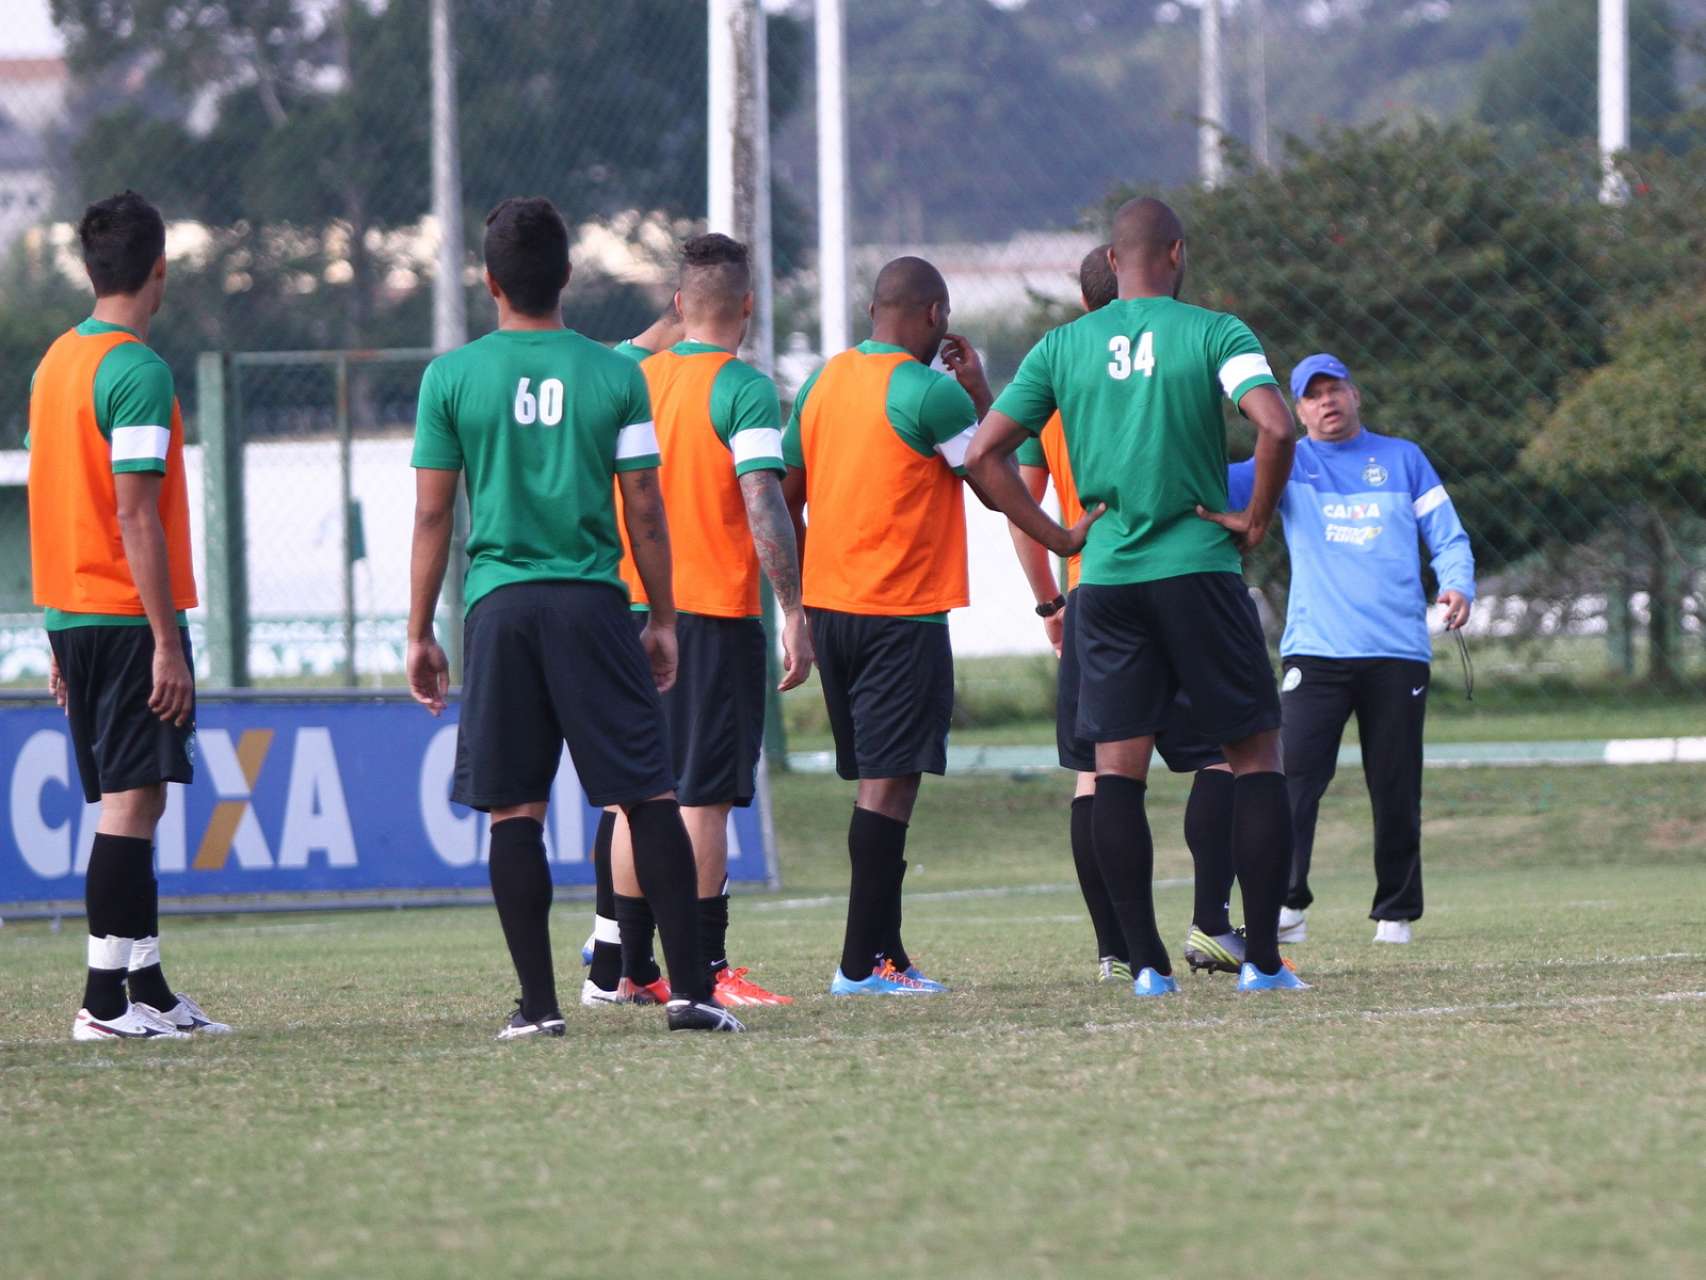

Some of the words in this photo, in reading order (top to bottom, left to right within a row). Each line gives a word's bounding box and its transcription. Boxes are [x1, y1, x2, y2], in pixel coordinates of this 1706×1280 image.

[1108, 331, 1155, 380] 34
[514, 377, 564, 426] 60
[1323, 503, 1381, 519] CAIXA
[10, 726, 359, 879] CIXA
